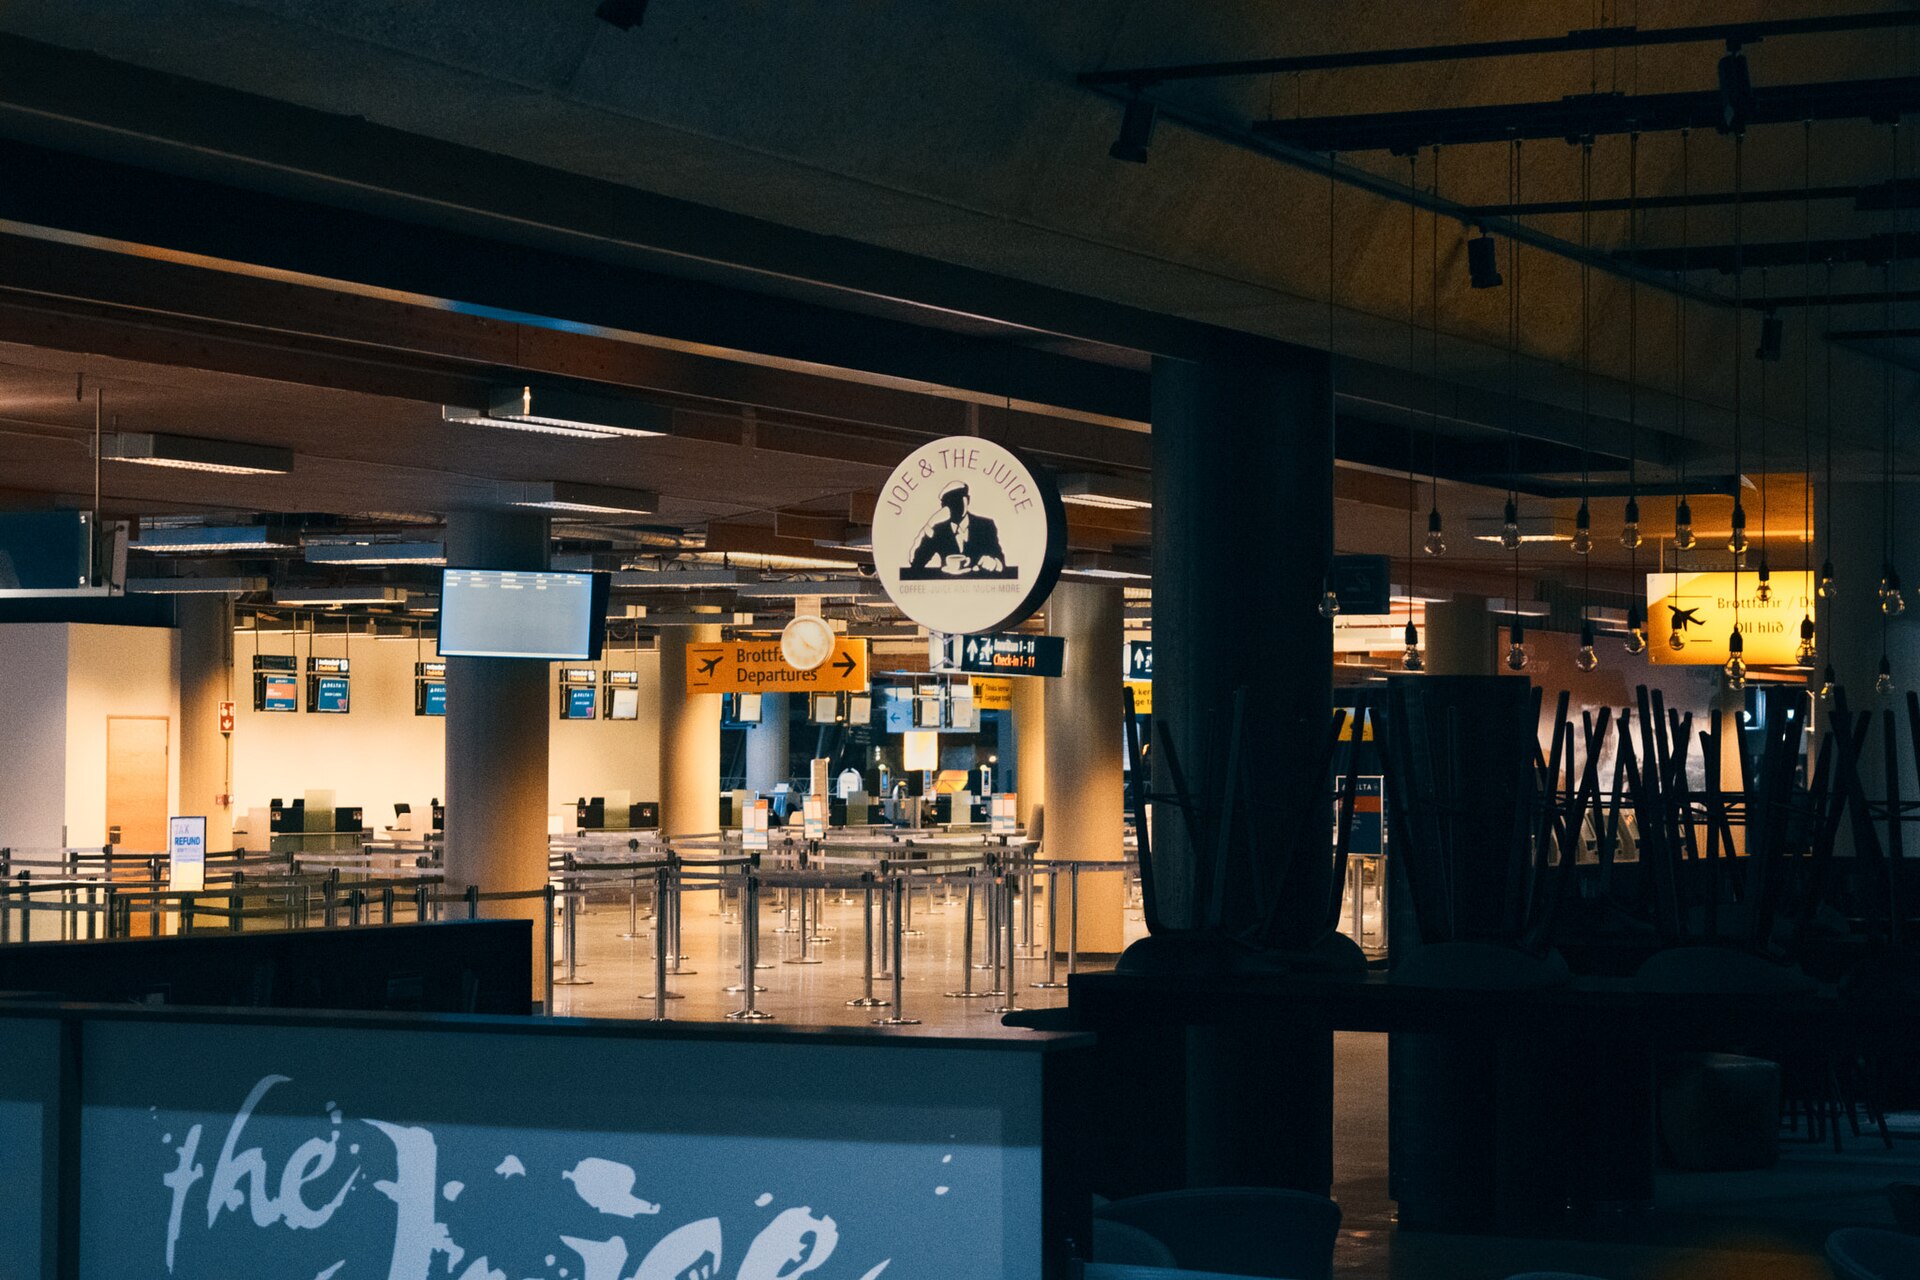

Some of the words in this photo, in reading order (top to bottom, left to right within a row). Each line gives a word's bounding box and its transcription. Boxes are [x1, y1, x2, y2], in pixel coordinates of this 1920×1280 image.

[887, 472, 919, 515] JOE
[918, 459, 934, 478] &
[938, 448, 980, 470] THE
[983, 460, 1033, 514] JUICE
[899, 585, 926, 594] COFFEE
[999, 584, 1020, 593] MORE
[737, 647, 784, 662] Brottfa
[737, 668, 817, 685] Departures
[174, 836, 201, 846] REFUND
[163, 1074, 360, 1275] the
